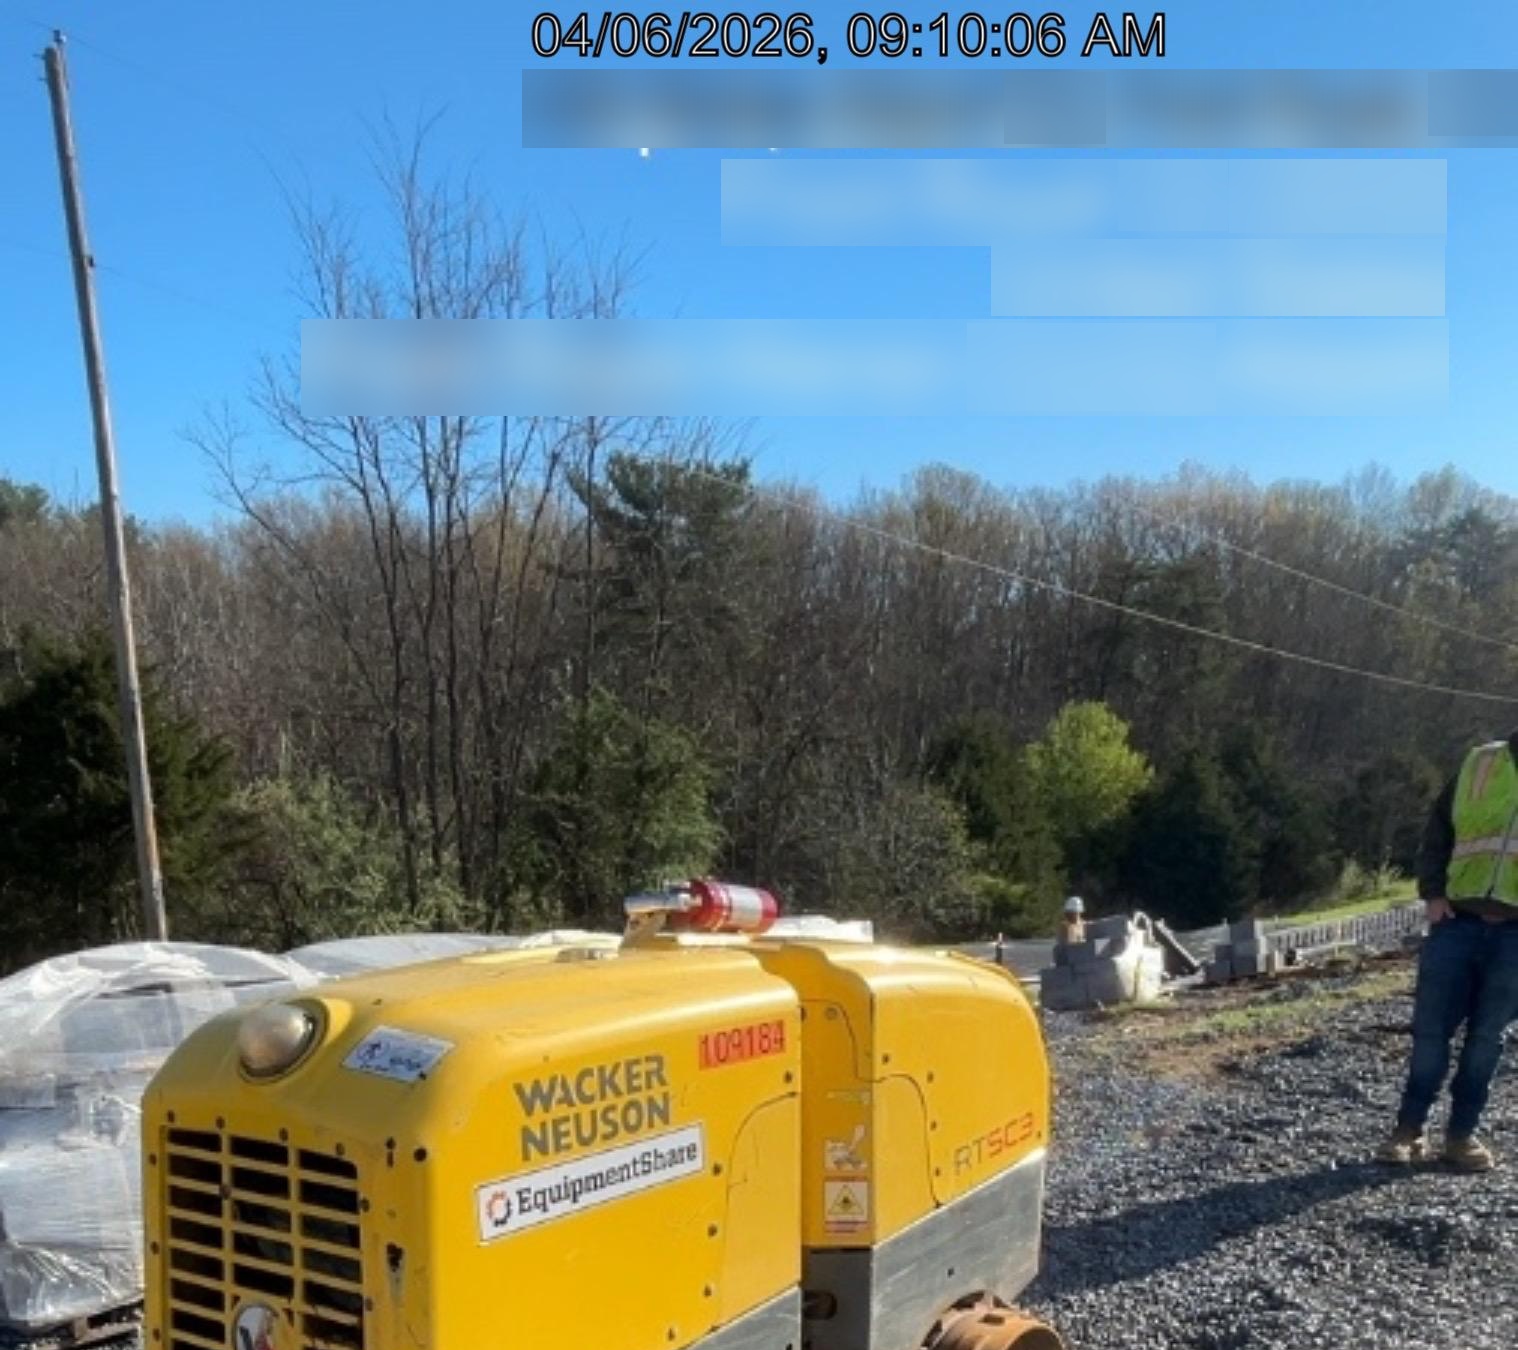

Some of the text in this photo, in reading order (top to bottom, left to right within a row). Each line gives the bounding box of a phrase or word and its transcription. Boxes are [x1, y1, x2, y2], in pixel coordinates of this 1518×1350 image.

[700, 1020, 785, 1067] 109184
[513, 1054, 667, 1117] WACKER
[521, 1092, 672, 1162] NEUSON
[516, 1141, 698, 1215] EquipmentShare
